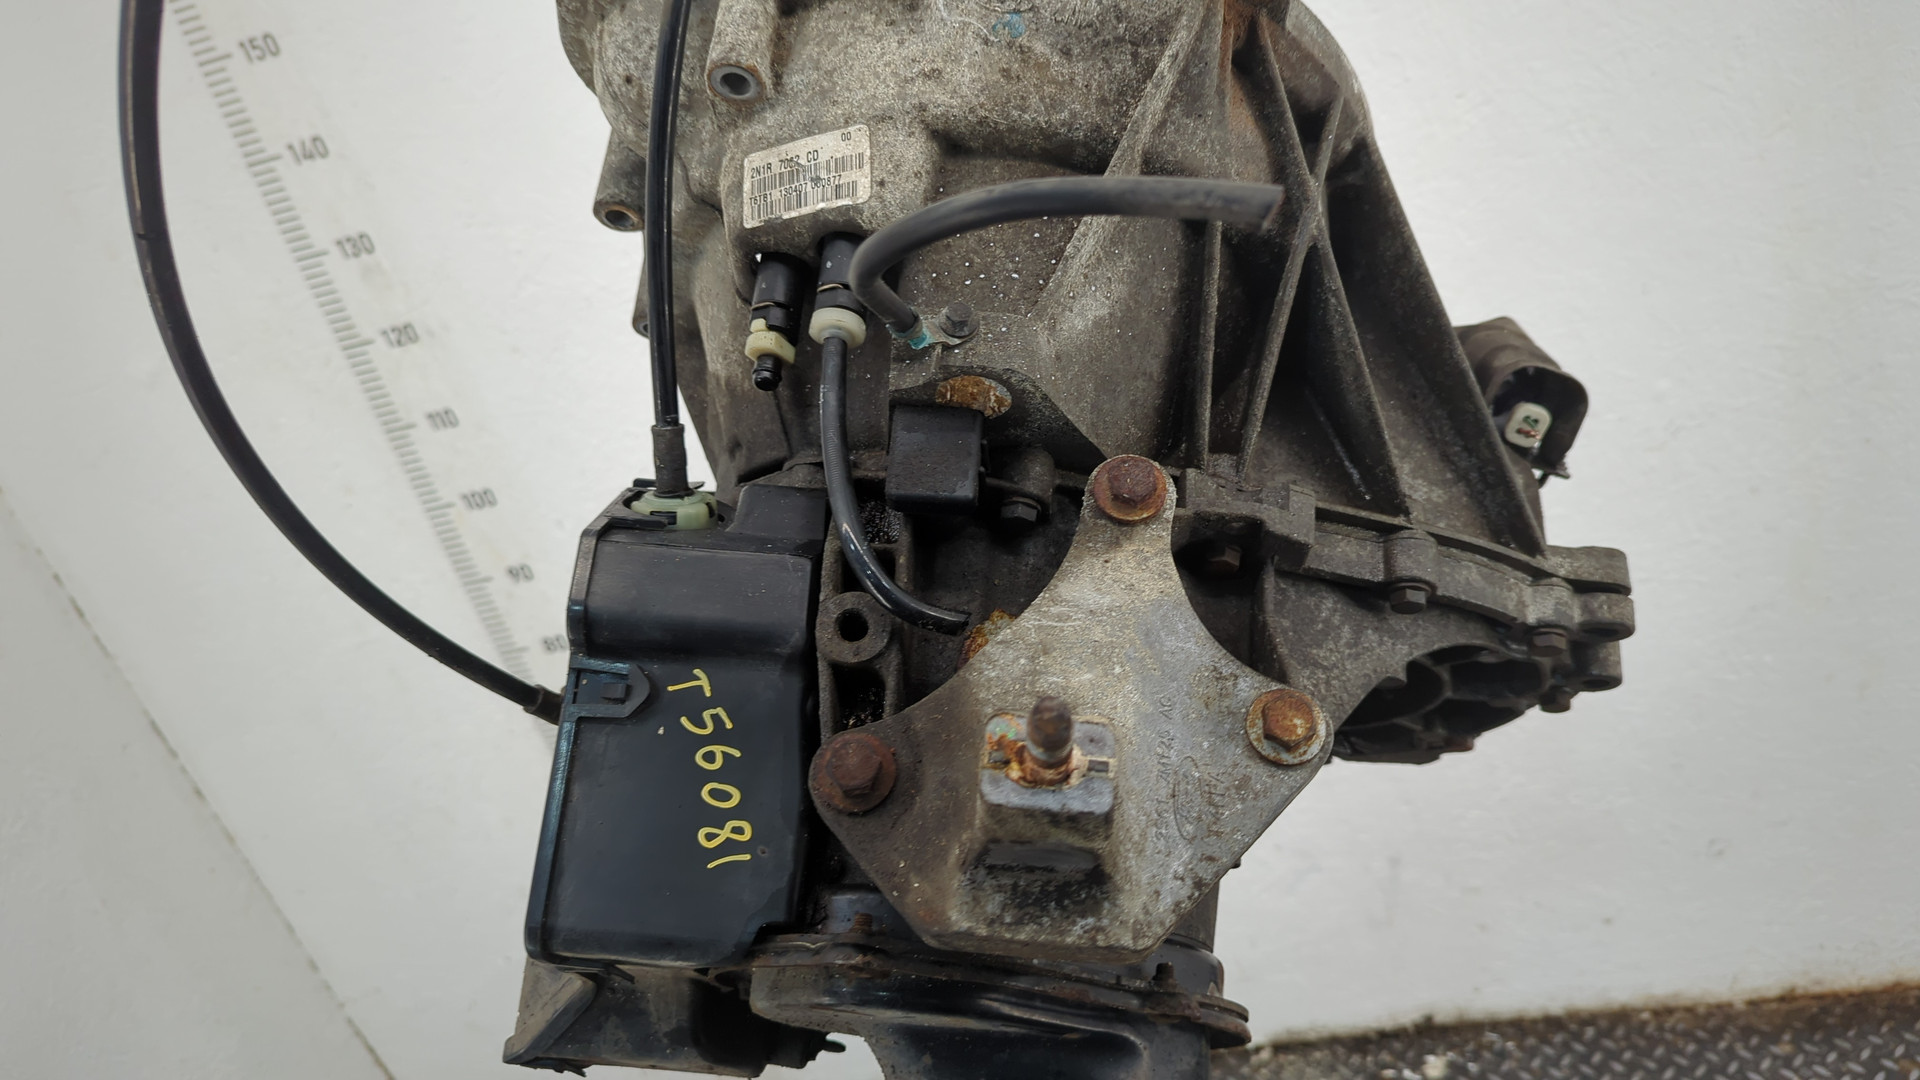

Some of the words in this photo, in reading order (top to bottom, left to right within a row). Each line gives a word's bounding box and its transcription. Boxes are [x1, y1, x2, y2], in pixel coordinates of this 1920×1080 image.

[238, 32, 281, 63] 150
[287, 134, 330, 165] 140
[841, 131, 852, 142] 00
[750, 162, 773, 179] 2N1R
[806, 149, 819, 164] CD
[334, 231, 376, 261] 130
[380, 321, 420, 348] 120
[425, 407, 460, 432] 110
[461, 487, 499, 512] 100
[506, 563, 535, 584] 90
[541, 633, 568, 655] 80
[666, 668, 753, 870] T56081
